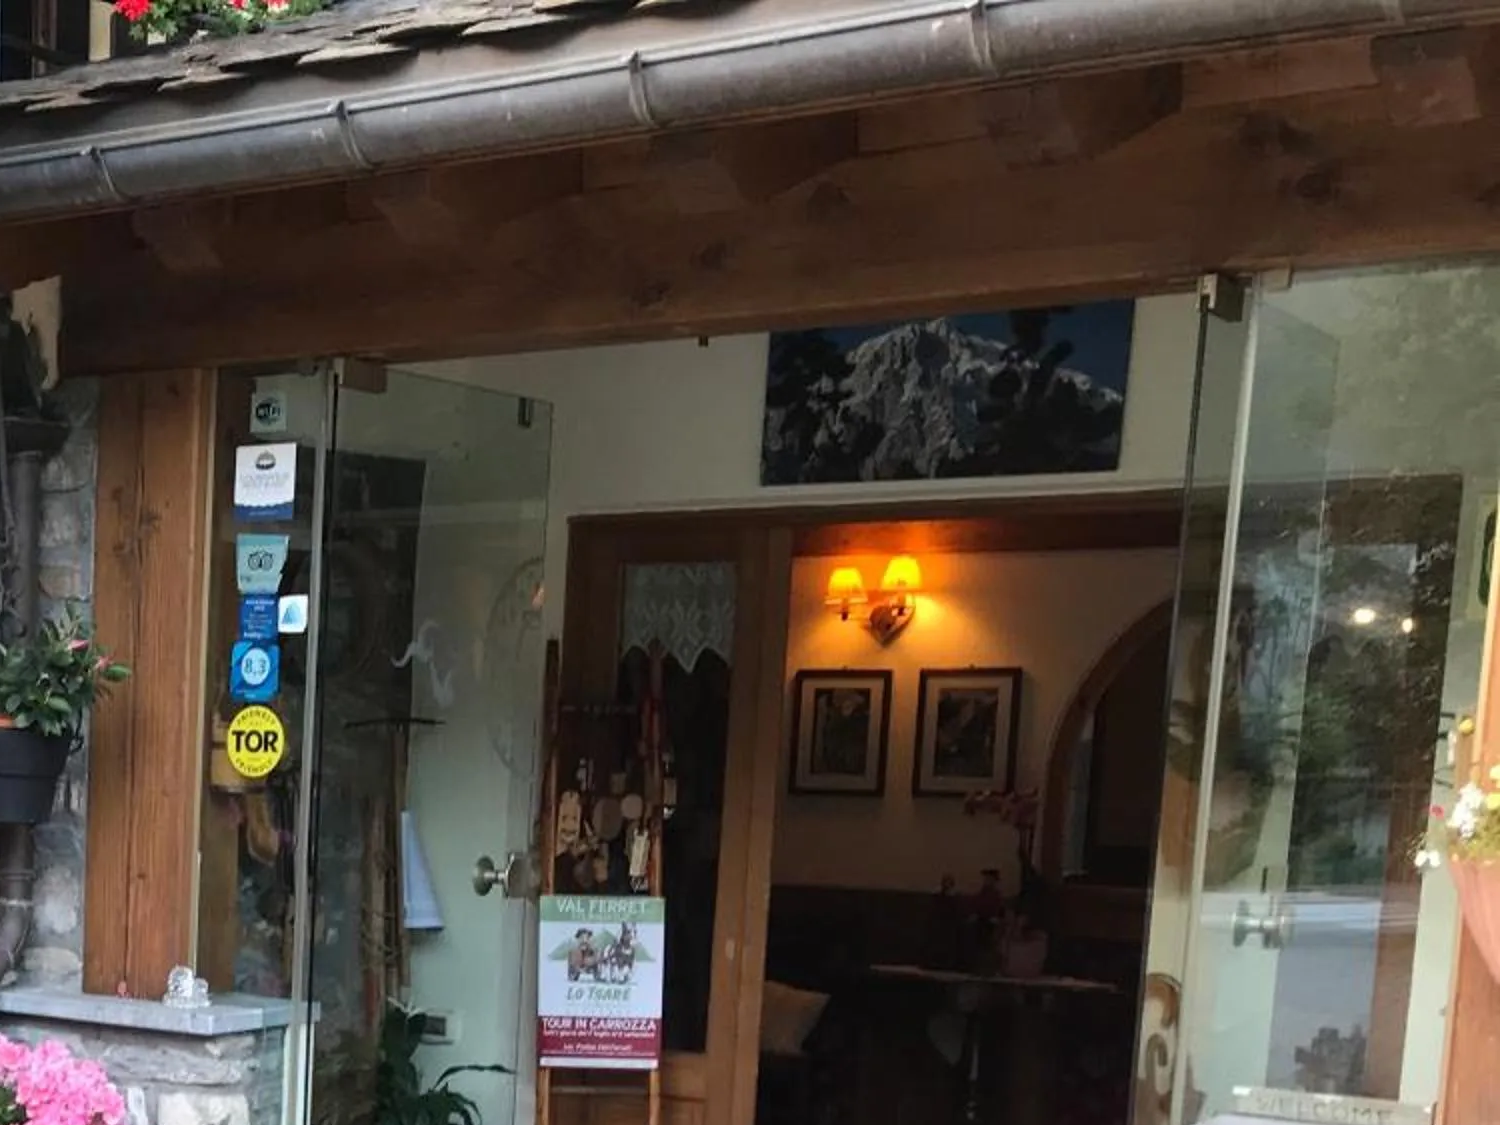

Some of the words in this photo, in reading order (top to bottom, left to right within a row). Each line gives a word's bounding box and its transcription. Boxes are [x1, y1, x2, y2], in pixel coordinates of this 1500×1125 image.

[232, 730, 278, 753] TOR
[556, 896, 585, 913] VAL
[588, 898, 647, 914] FERRET
[542, 1018, 572, 1030] TOUR
[575, 1018, 587, 1031] IN
[589, 1018, 656, 1031] CARROZZA
